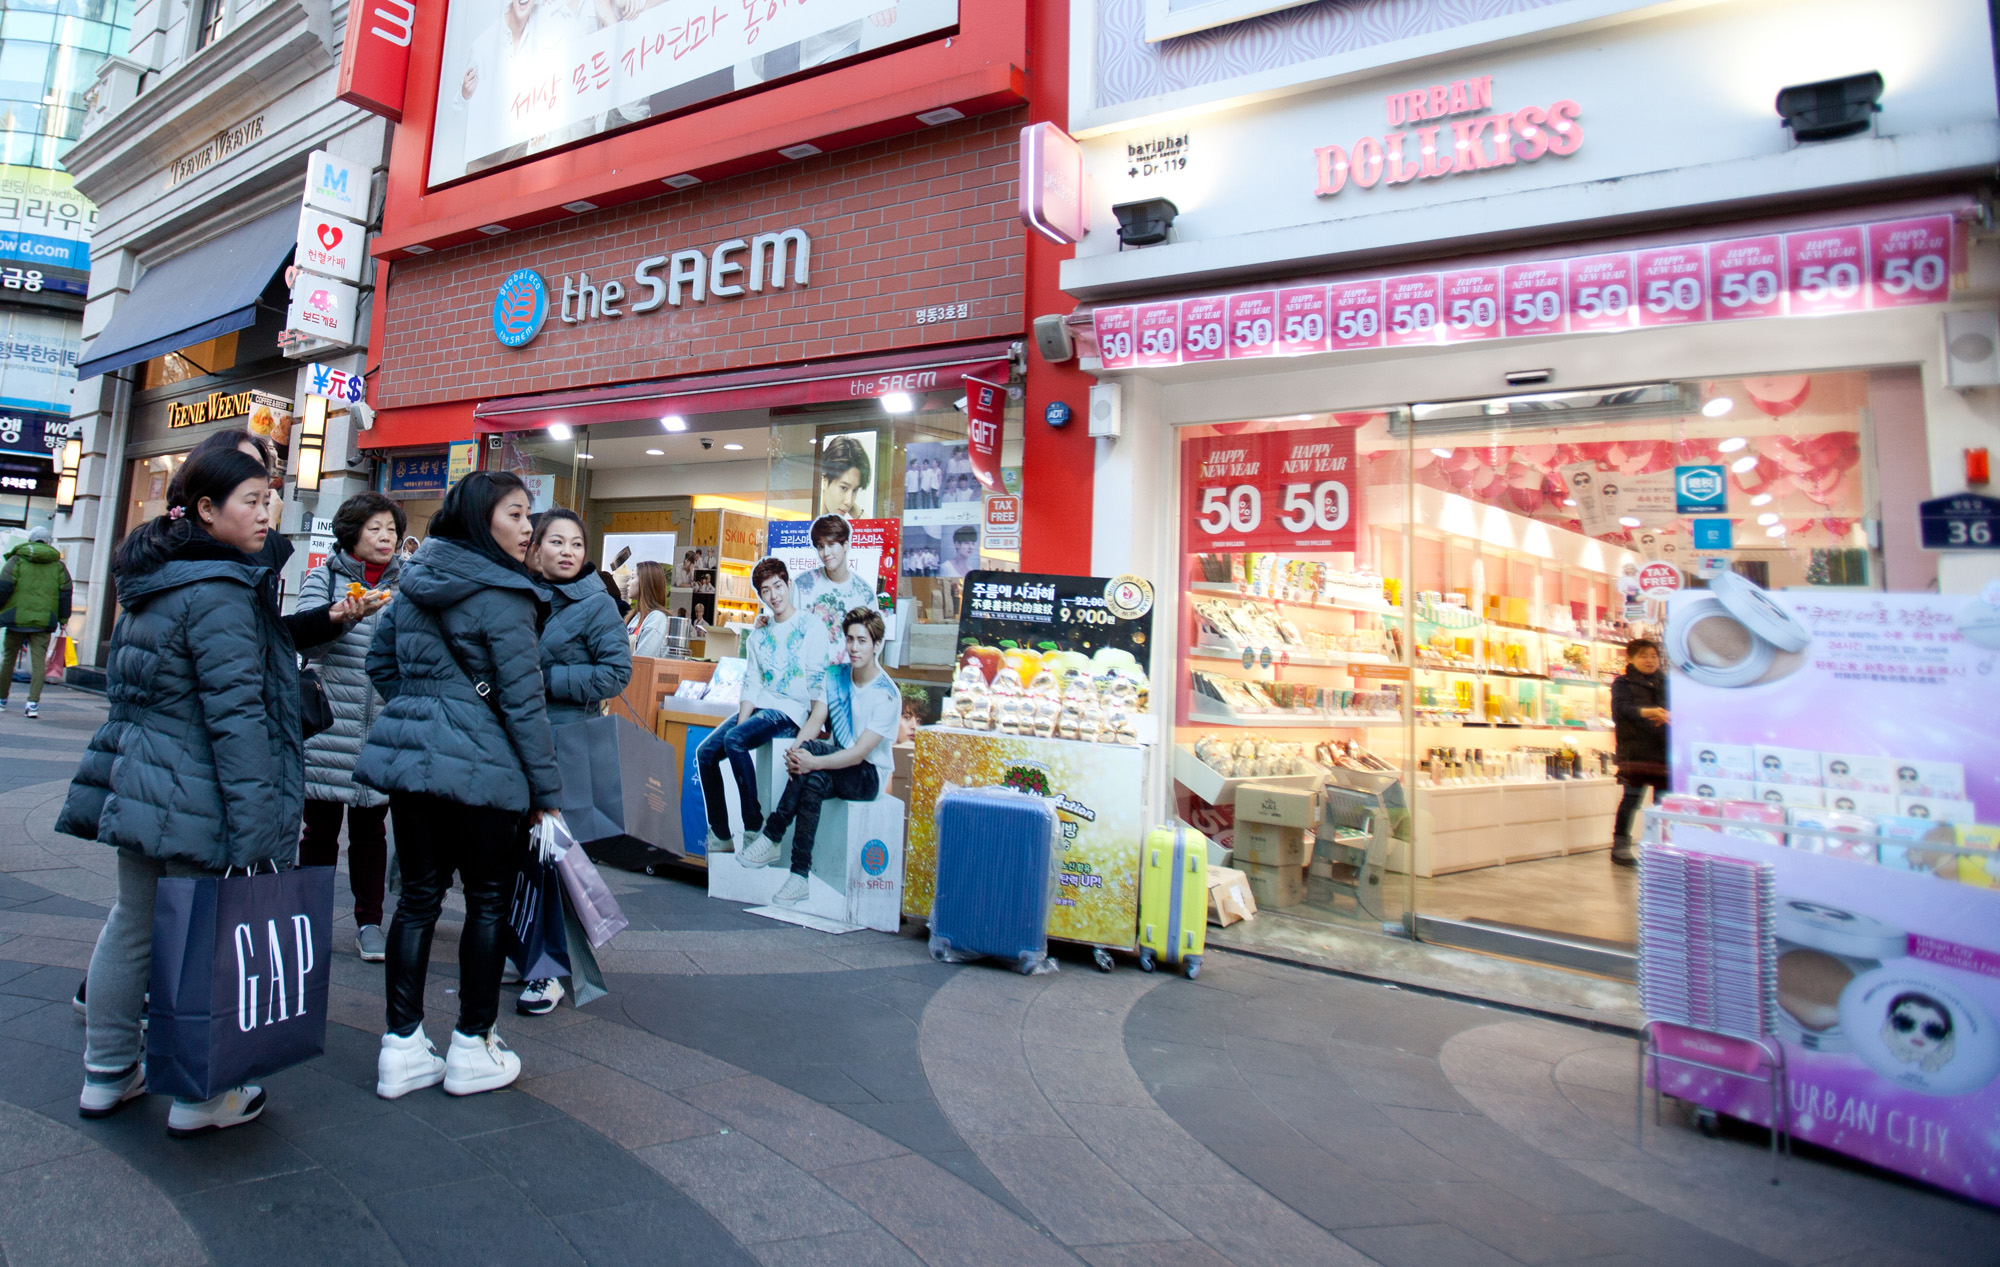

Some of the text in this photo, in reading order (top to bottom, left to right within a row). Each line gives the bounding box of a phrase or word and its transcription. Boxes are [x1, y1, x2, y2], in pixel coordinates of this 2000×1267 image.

[510, 5, 729, 121] 세상 모든 자연과
[1386, 75, 1493, 126] URBAN
[1128, 133, 1189, 157] baviphat
[1313, 99, 1585, 197] DOLLKISS
[323, 163, 349, 193] M
[1143, 157, 1187, 177] Dr.119
[0, 266, 45, 292] 금융
[561, 228, 812, 324] the SAEM
[915, 302, 969, 324] 명동3호점
[850, 371, 937, 396] the SAEM
[167, 391, 253, 429] TEENIE WEENIE
[1047, 409, 1064, 419] ADT
[971, 418, 998, 446] GIFT
[1209, 449, 1248, 465] HAPPY
[1291, 443, 1334, 459] HAPPY
[1200, 461, 1260, 478] NEW YEAR
[1280, 456, 1347, 474] NEW YEAR
[992, 500, 1013, 510] TAX
[1199, 484, 1262, 535] 50
[1281, 480, 1349, 533] 50
[990, 511, 1015, 522] FREE
[725, 528, 746, 544] SKIN
[1949, 521, 1992, 543] 36
[1643, 577, 1676, 587] FREE
[1645, 567, 1670, 577] TAX
[971, 582, 1056, 601] 주름에 사과해
[1828, 640, 1862, 651] 24시간
[1055, 792, 1096, 822] Action
[853, 880, 865, 889] the
[1080, 874, 1102, 888] UP!
[507, 870, 538, 944] GAP
[234, 914, 314, 1032] GAP
[1789, 1080, 1949, 1159] URBAN CITY
